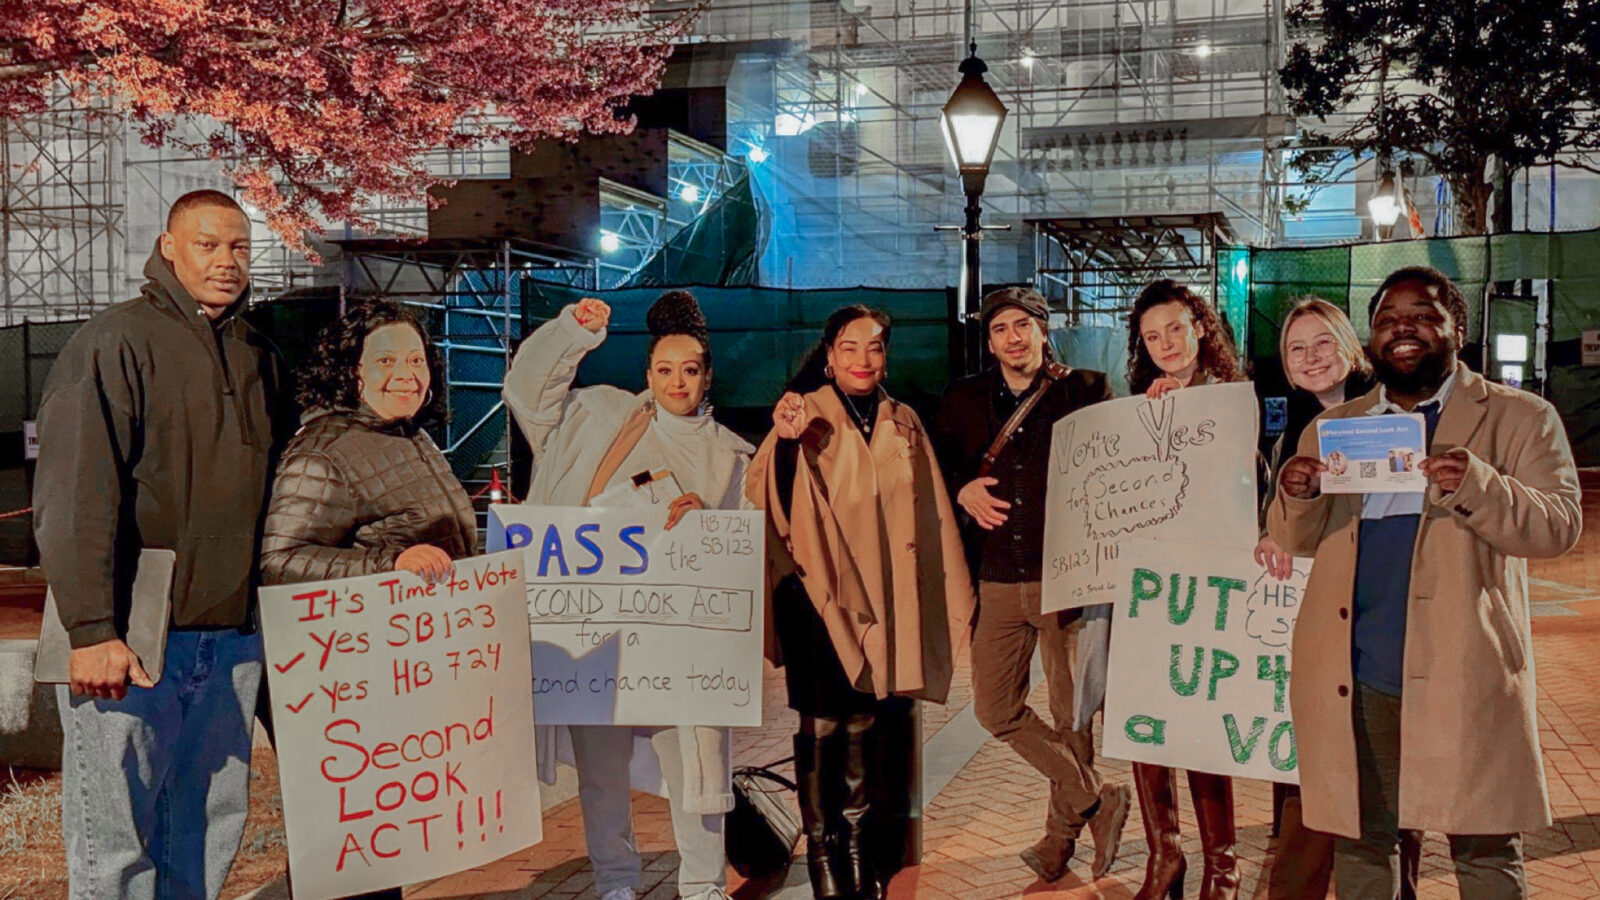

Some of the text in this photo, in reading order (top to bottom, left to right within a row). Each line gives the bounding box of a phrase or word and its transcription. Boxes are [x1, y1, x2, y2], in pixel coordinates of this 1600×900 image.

[1055, 395, 1216, 475] Vote Yes
[1094, 463, 1173, 499] Second
[1094, 498, 1166, 521] Chances
[504, 523, 702, 577] PASS the
[292, 563, 518, 622] It's Time to Vote
[618, 588, 678, 615] LOOK
[690, 588, 739, 615] ACT
[1129, 567, 1247, 631] PUT
[575, 617, 640, 648] for a
[393, 658, 433, 696] HB
[446, 642, 501, 680] 724
[588, 670, 672, 693] chance
[687, 664, 750, 707] today
[1169, 644, 1291, 713] UP 4
[320, 696, 494, 783] Second
[1124, 714, 1167, 746] a
[339, 761, 468, 823] LOOK
